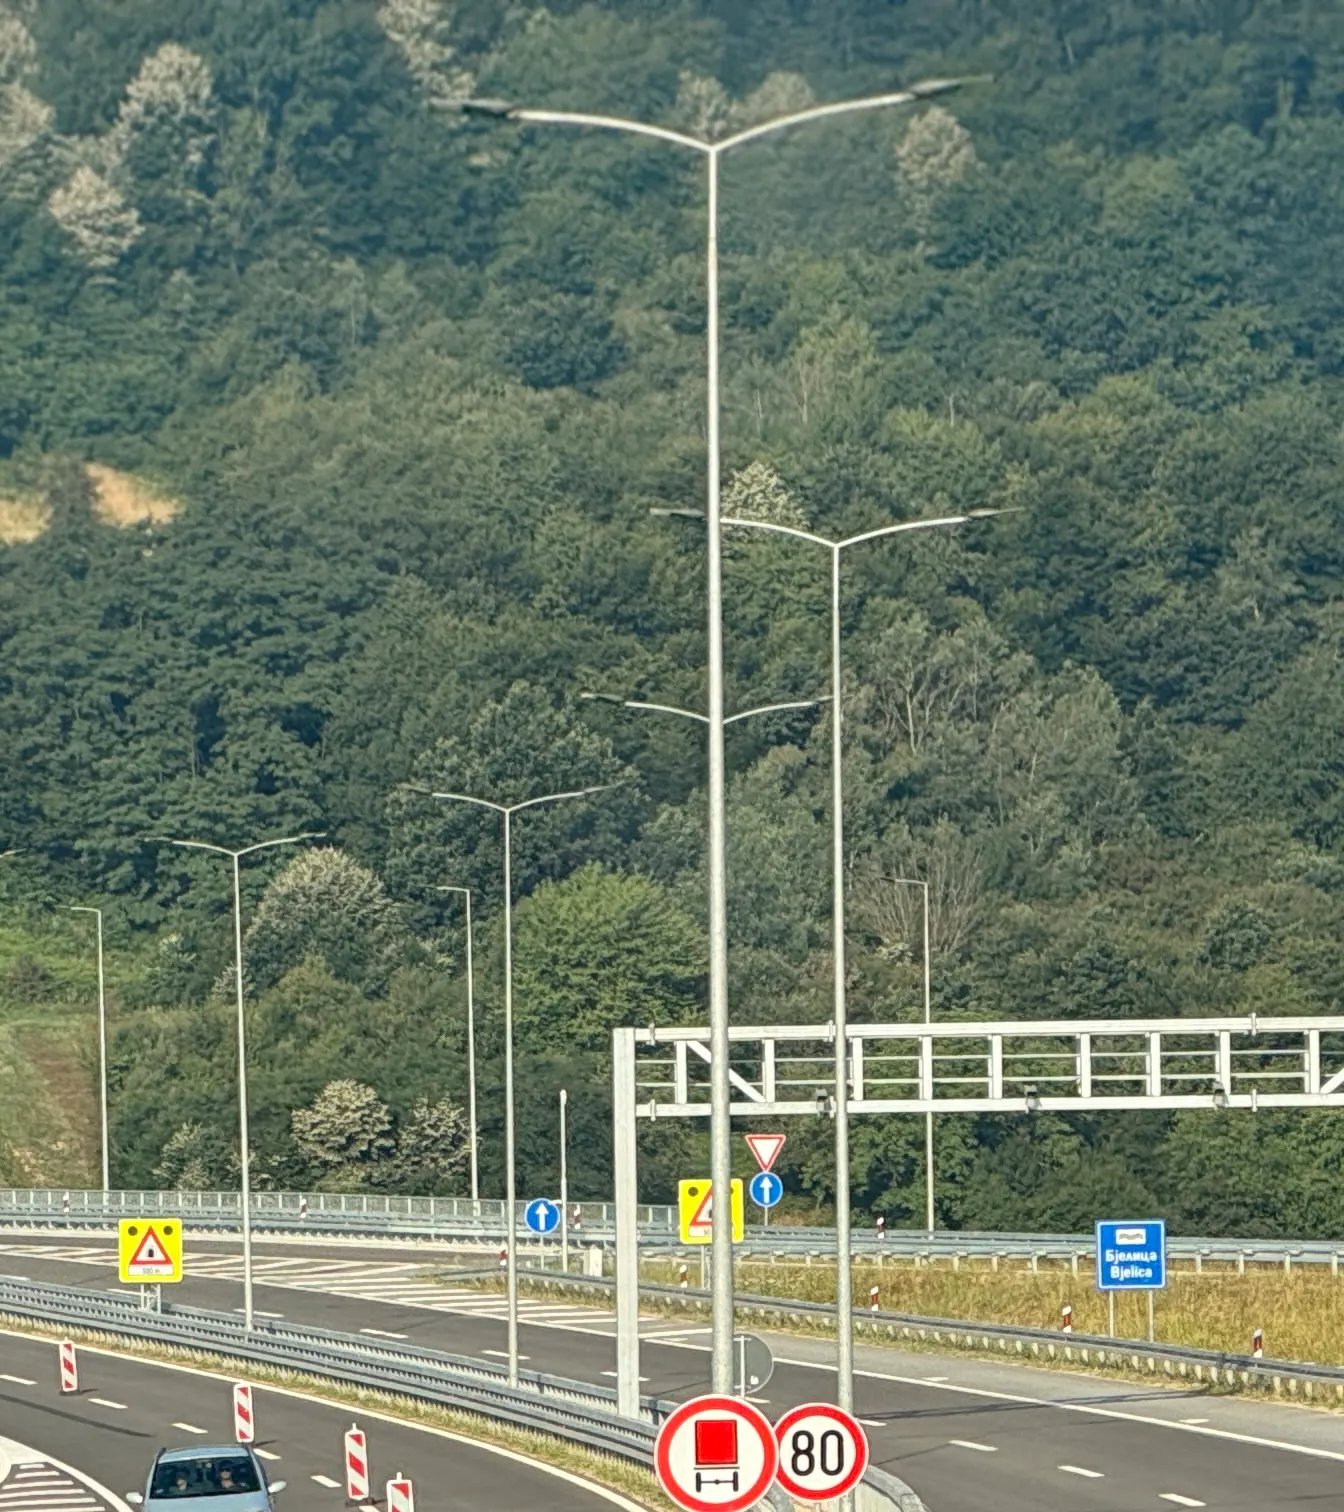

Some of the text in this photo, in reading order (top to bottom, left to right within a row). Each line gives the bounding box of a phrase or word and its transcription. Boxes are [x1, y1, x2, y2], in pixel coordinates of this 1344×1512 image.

[1105, 1249, 1157, 1264] Бјелица
[1110, 1264, 1153, 1281] Bjelica
[791, 1430, 844, 1476] 80
